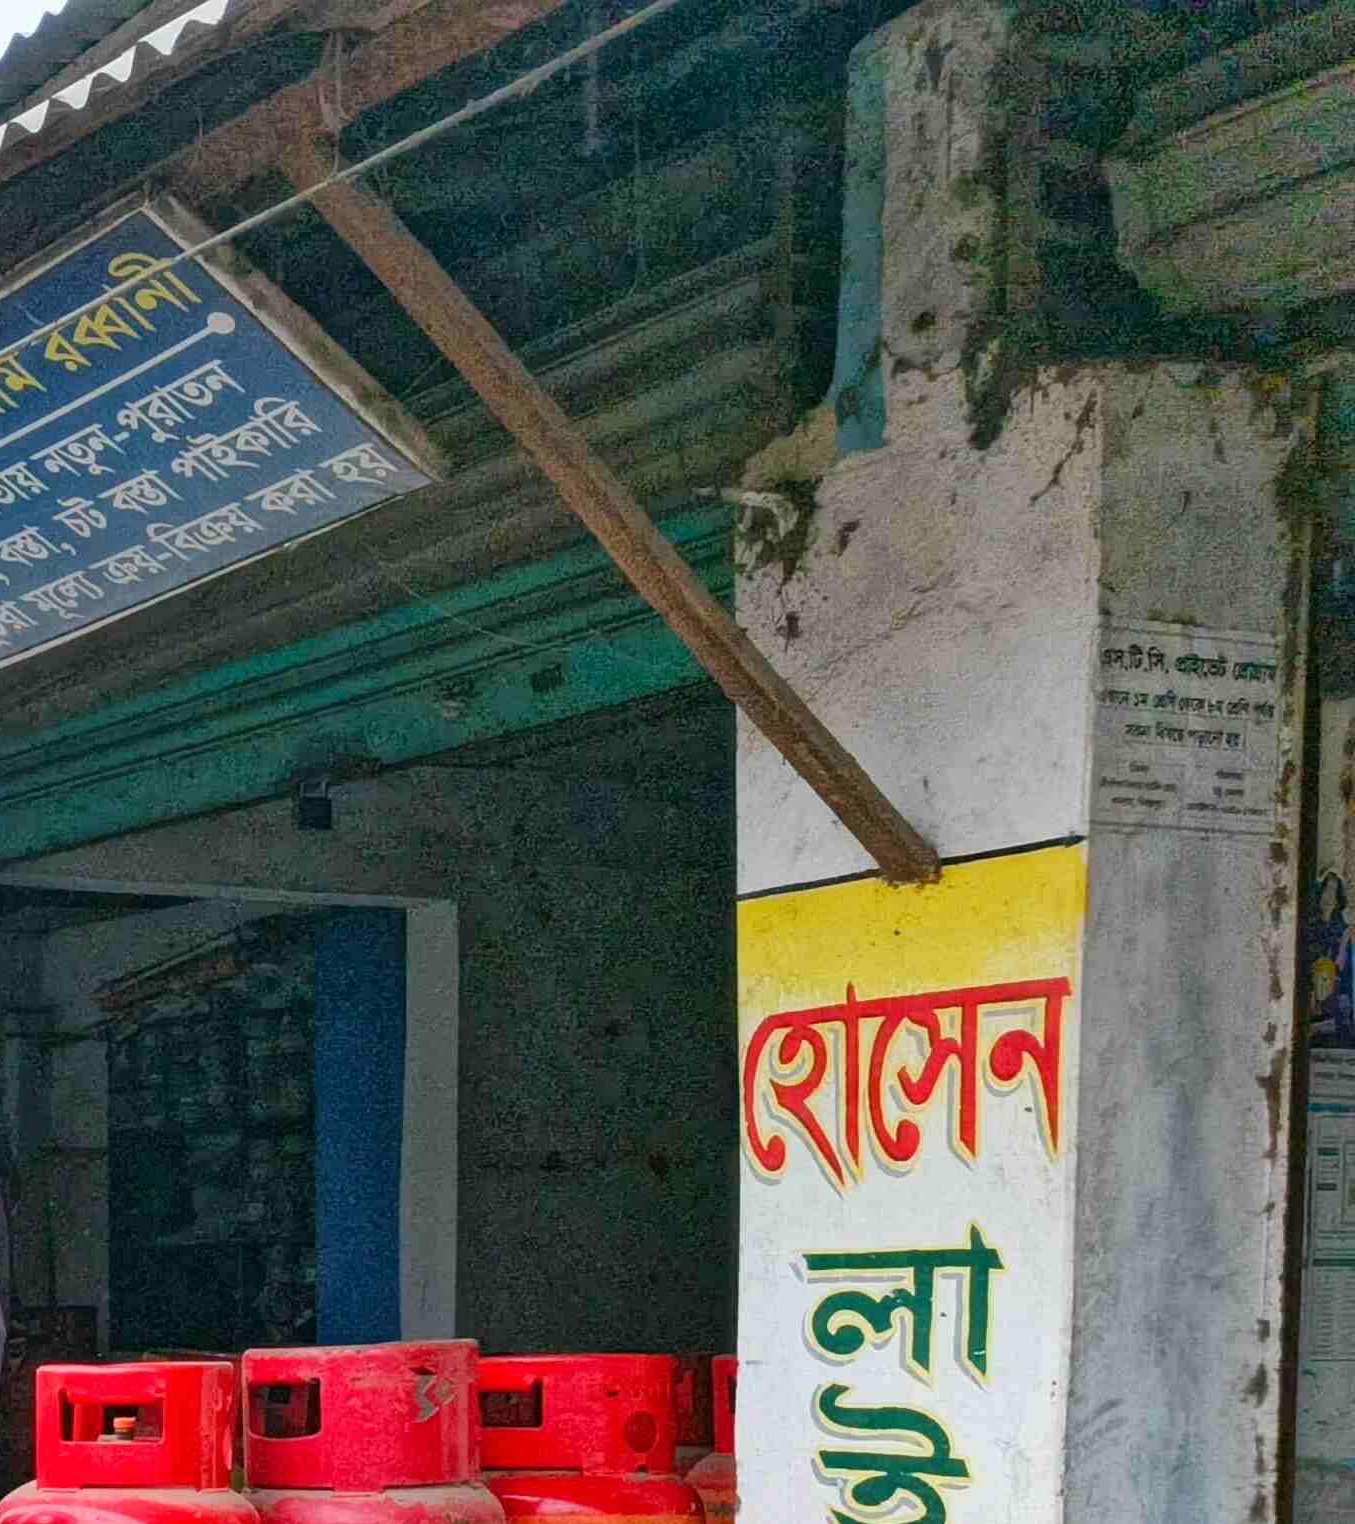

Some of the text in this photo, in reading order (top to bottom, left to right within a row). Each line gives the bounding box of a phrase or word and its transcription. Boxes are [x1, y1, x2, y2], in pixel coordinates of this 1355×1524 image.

[52, 500, 107, 541] চট
[170, 396, 322, 488] পাইকারি
[245, 467, 335, 518] করা
[331, 440, 400, 487] হয়
[743, 973, 1073, 1188] হোসেন
